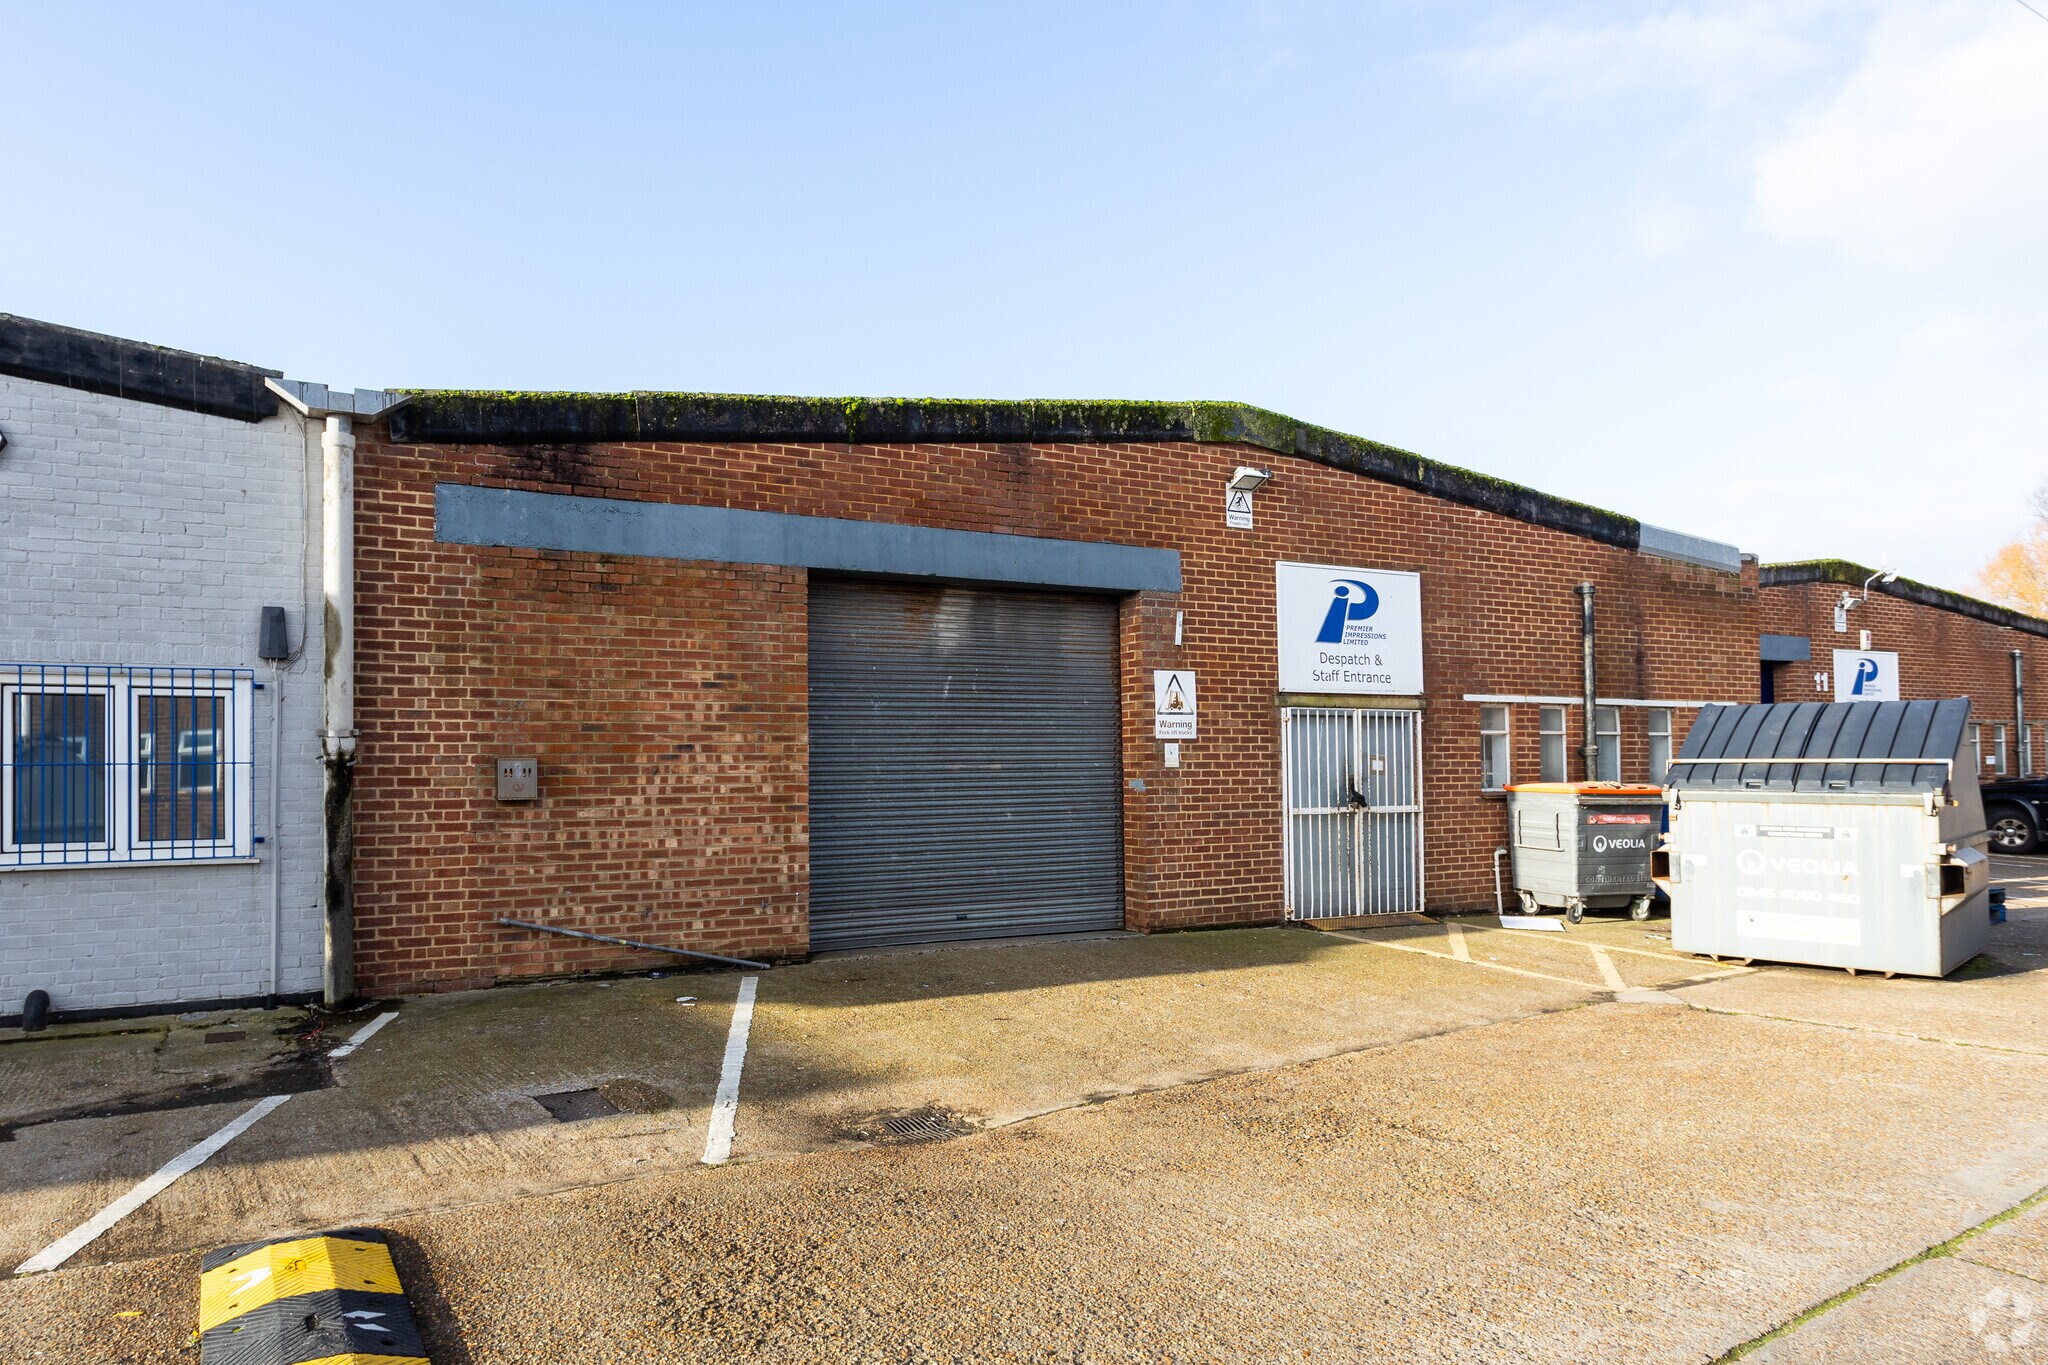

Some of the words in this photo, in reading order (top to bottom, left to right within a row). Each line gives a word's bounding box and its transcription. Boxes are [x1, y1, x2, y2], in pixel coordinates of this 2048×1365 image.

[1229, 514, 1250, 523] Warning
[1344, 632, 1387, 640] IMPRESSIONS
[1319, 652, 1371, 668] Despatch
[1374, 654, 1383, 666] &
[1312, 669, 1340, 682] Staff
[1343, 670, 1392, 684] Entrance
[1814, 672, 1829, 692] 11
[1159, 720, 1193, 730] Warning
[1608, 839, 1646, 849] VEOLIA
[1770, 858, 1859, 877] VEOLIA
